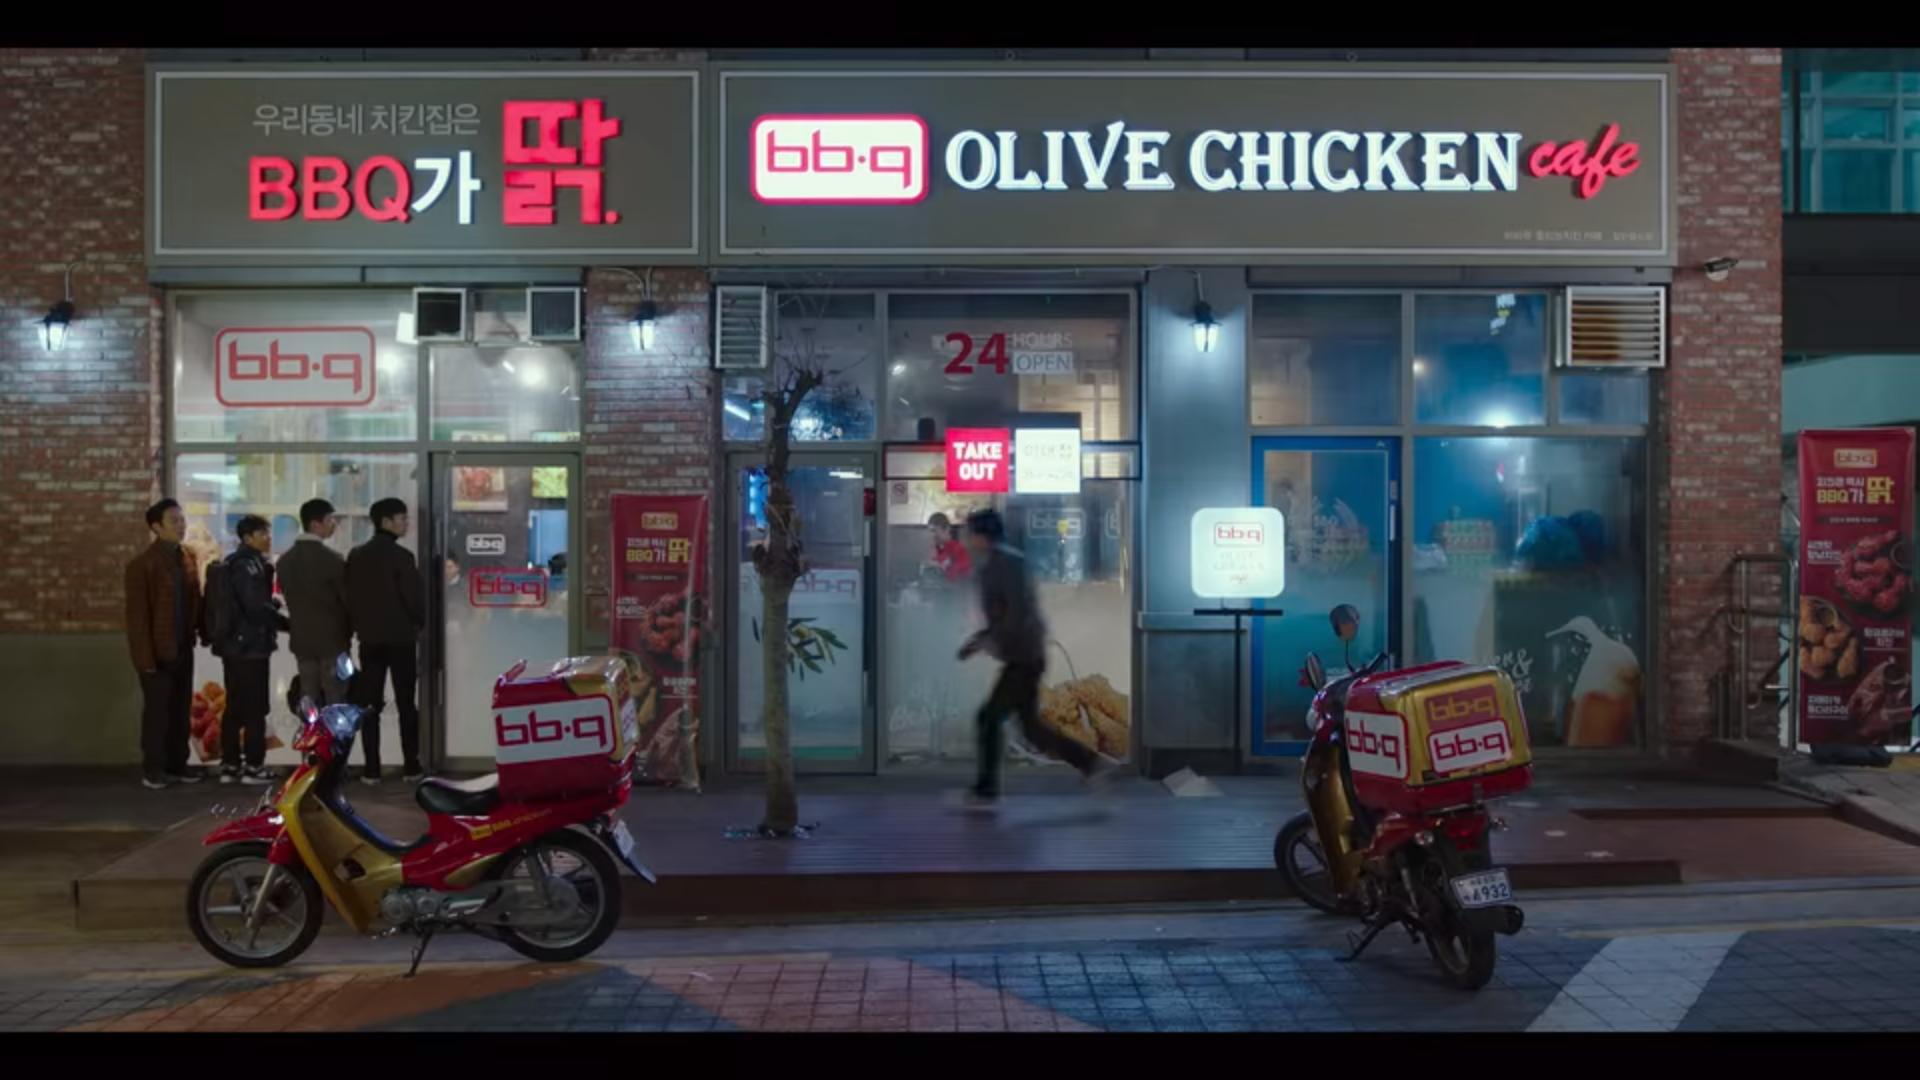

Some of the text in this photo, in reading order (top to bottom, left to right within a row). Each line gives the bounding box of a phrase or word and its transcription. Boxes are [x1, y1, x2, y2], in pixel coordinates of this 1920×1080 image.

[252, 103, 480, 136] 우리동네 치킨집은
[945, 121, 1175, 191] OLIVE
[1189, 129, 1522, 191] CHICKEN
[1528, 122, 1642, 200] cafe
[248, 150, 481, 224] BBQ가
[944, 331, 1072, 375] 24 HOURS
[1016, 354, 1070, 371] OPEN
[953, 441, 1003, 461] TAKE
[958, 463, 997, 481] OUT
